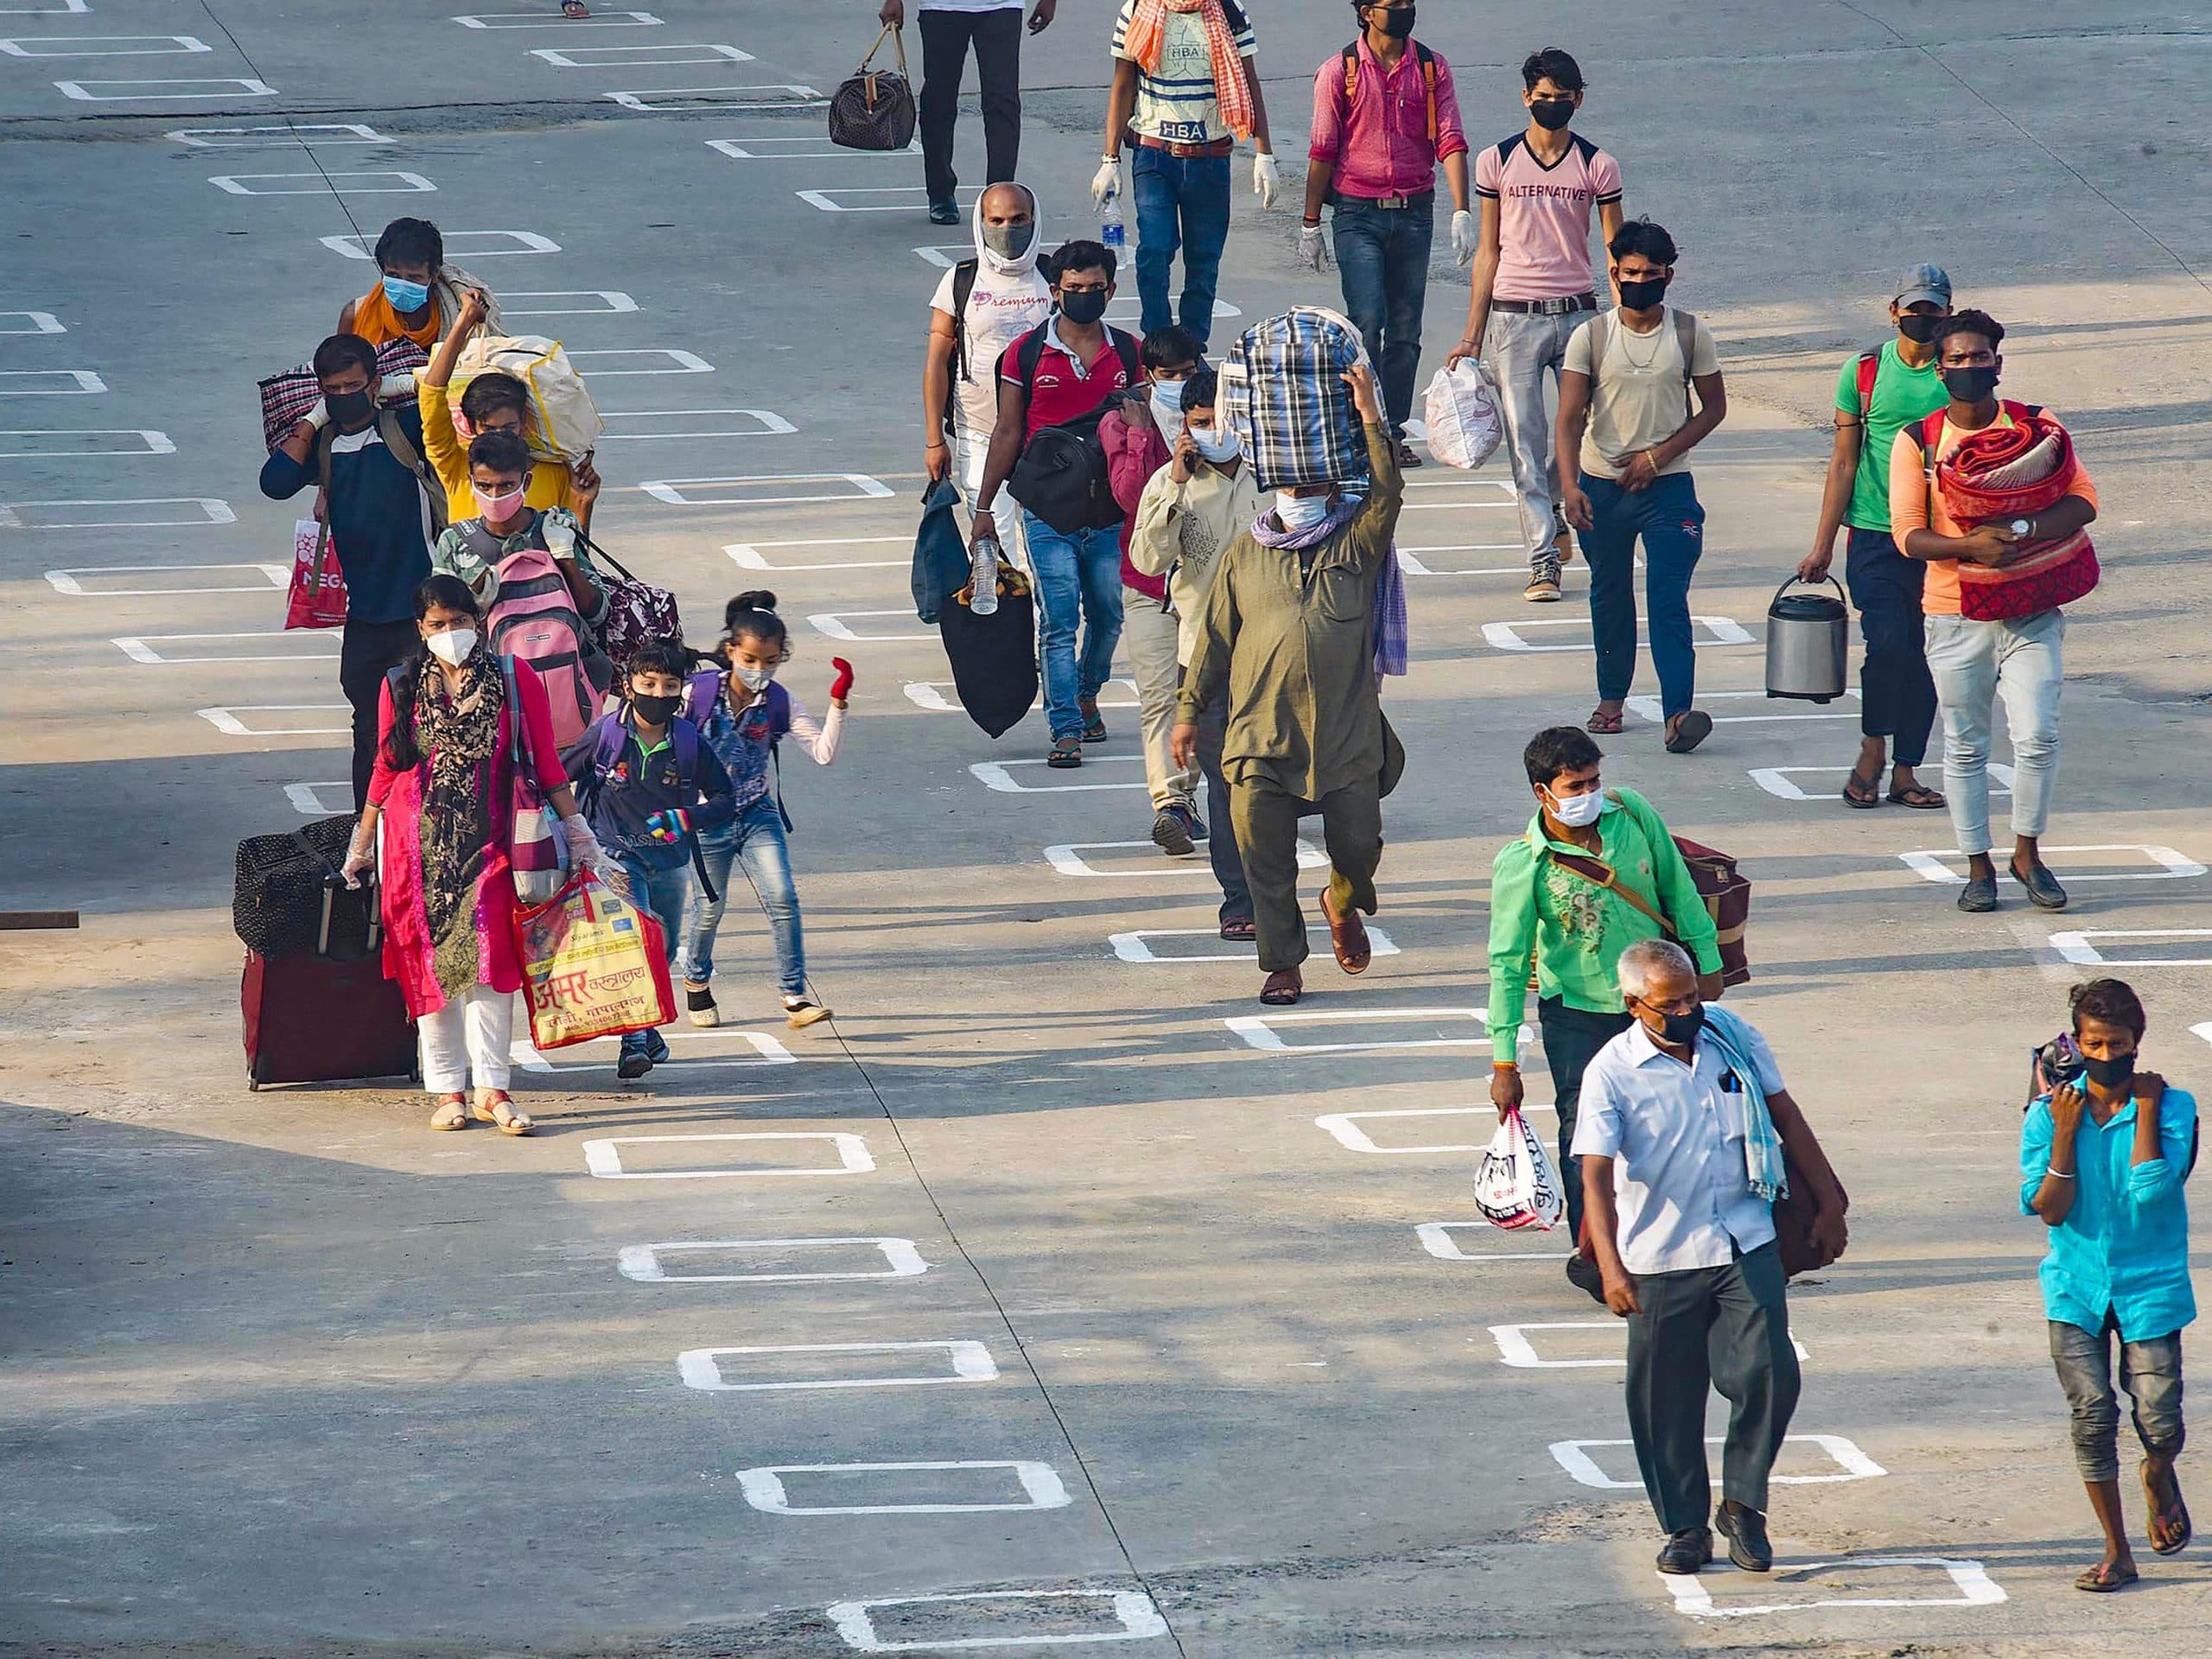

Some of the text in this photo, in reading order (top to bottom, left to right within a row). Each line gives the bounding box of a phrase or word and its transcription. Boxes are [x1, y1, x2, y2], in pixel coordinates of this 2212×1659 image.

[1172, 48, 1199, 57] HBA
[1163, 123, 1203, 139] HBA
[1509, 185, 1586, 200] ALTERNATIVE
[974, 291, 1048, 311] Premium
[536, 966, 645, 1009] अमर वस्त्रालय
